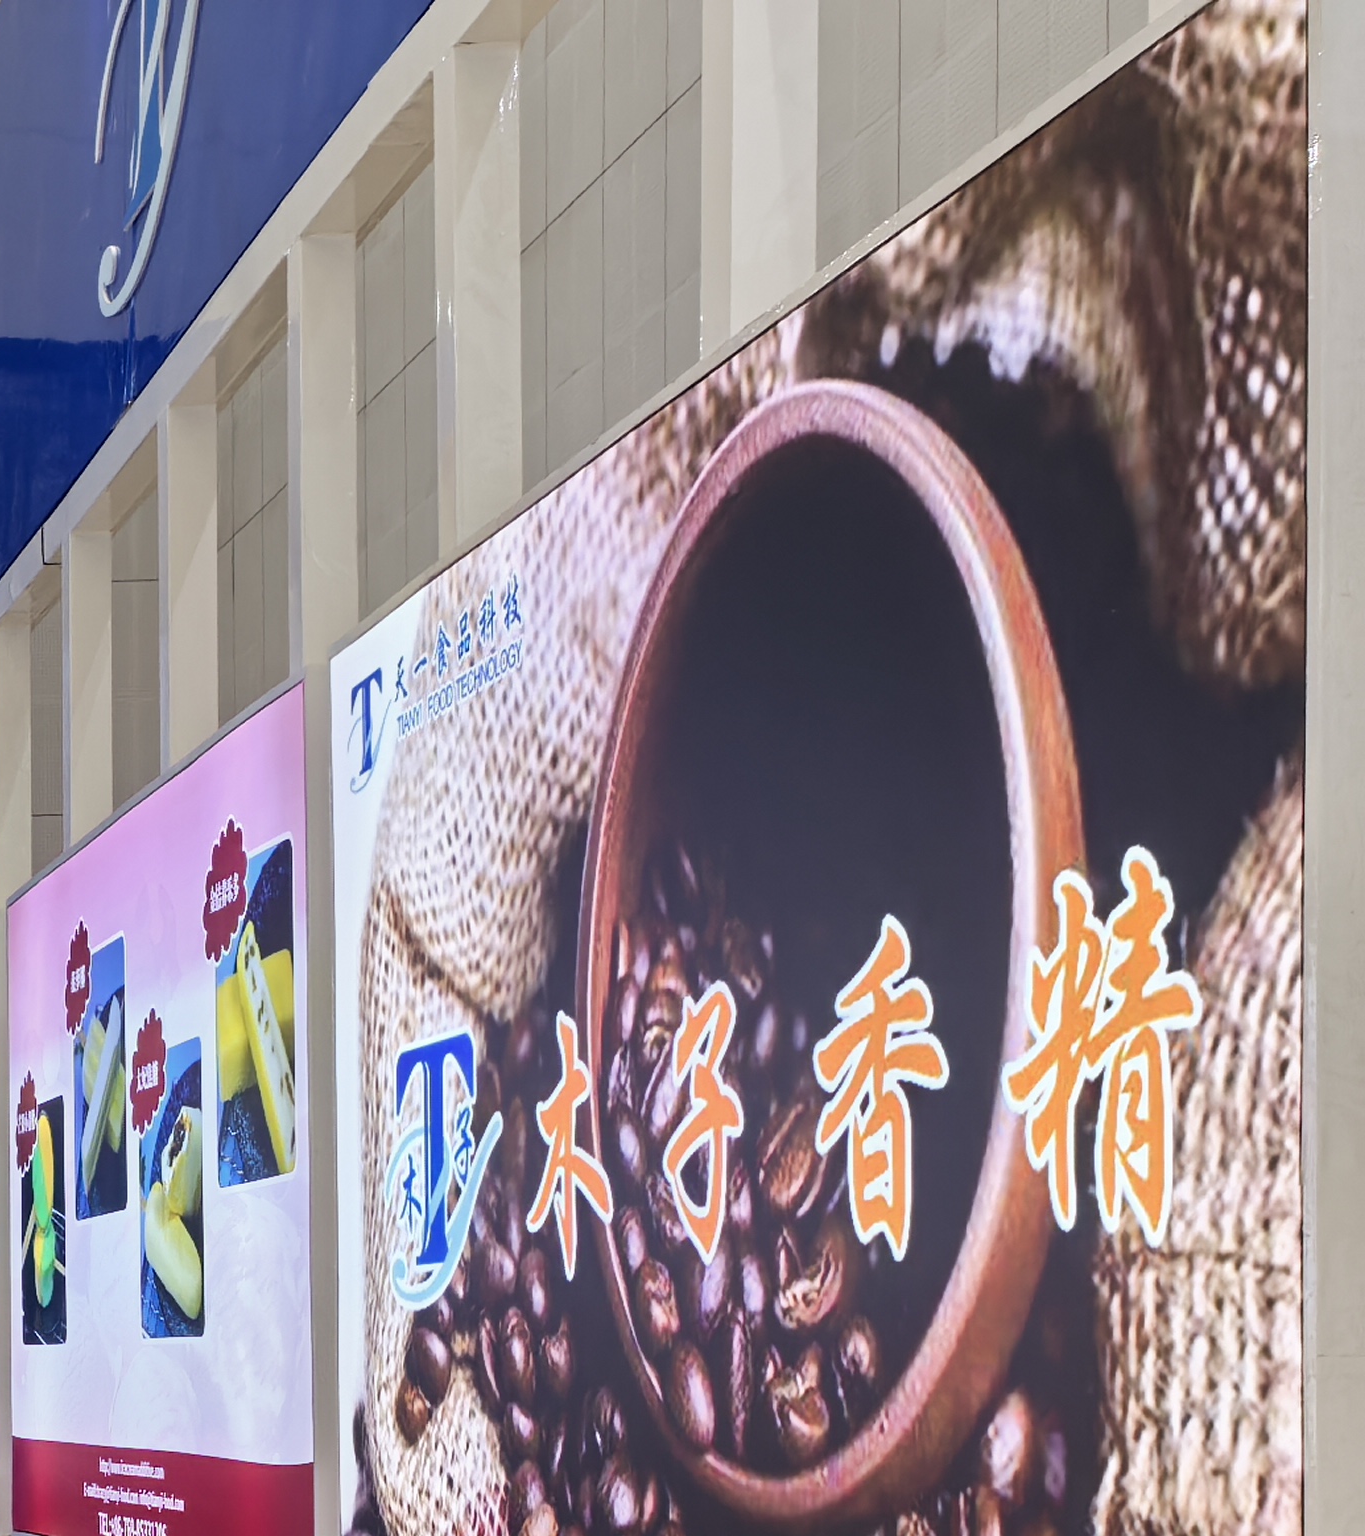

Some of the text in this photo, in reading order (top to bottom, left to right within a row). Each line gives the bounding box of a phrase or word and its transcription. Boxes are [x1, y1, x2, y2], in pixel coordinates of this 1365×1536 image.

[395, 574, 522, 702] 天一食品科技
[427, 685, 453, 719] FOOD
[456, 639, 523, 699] TECHNOLOGY
[526, 846, 1200, 1281] 木子香精
